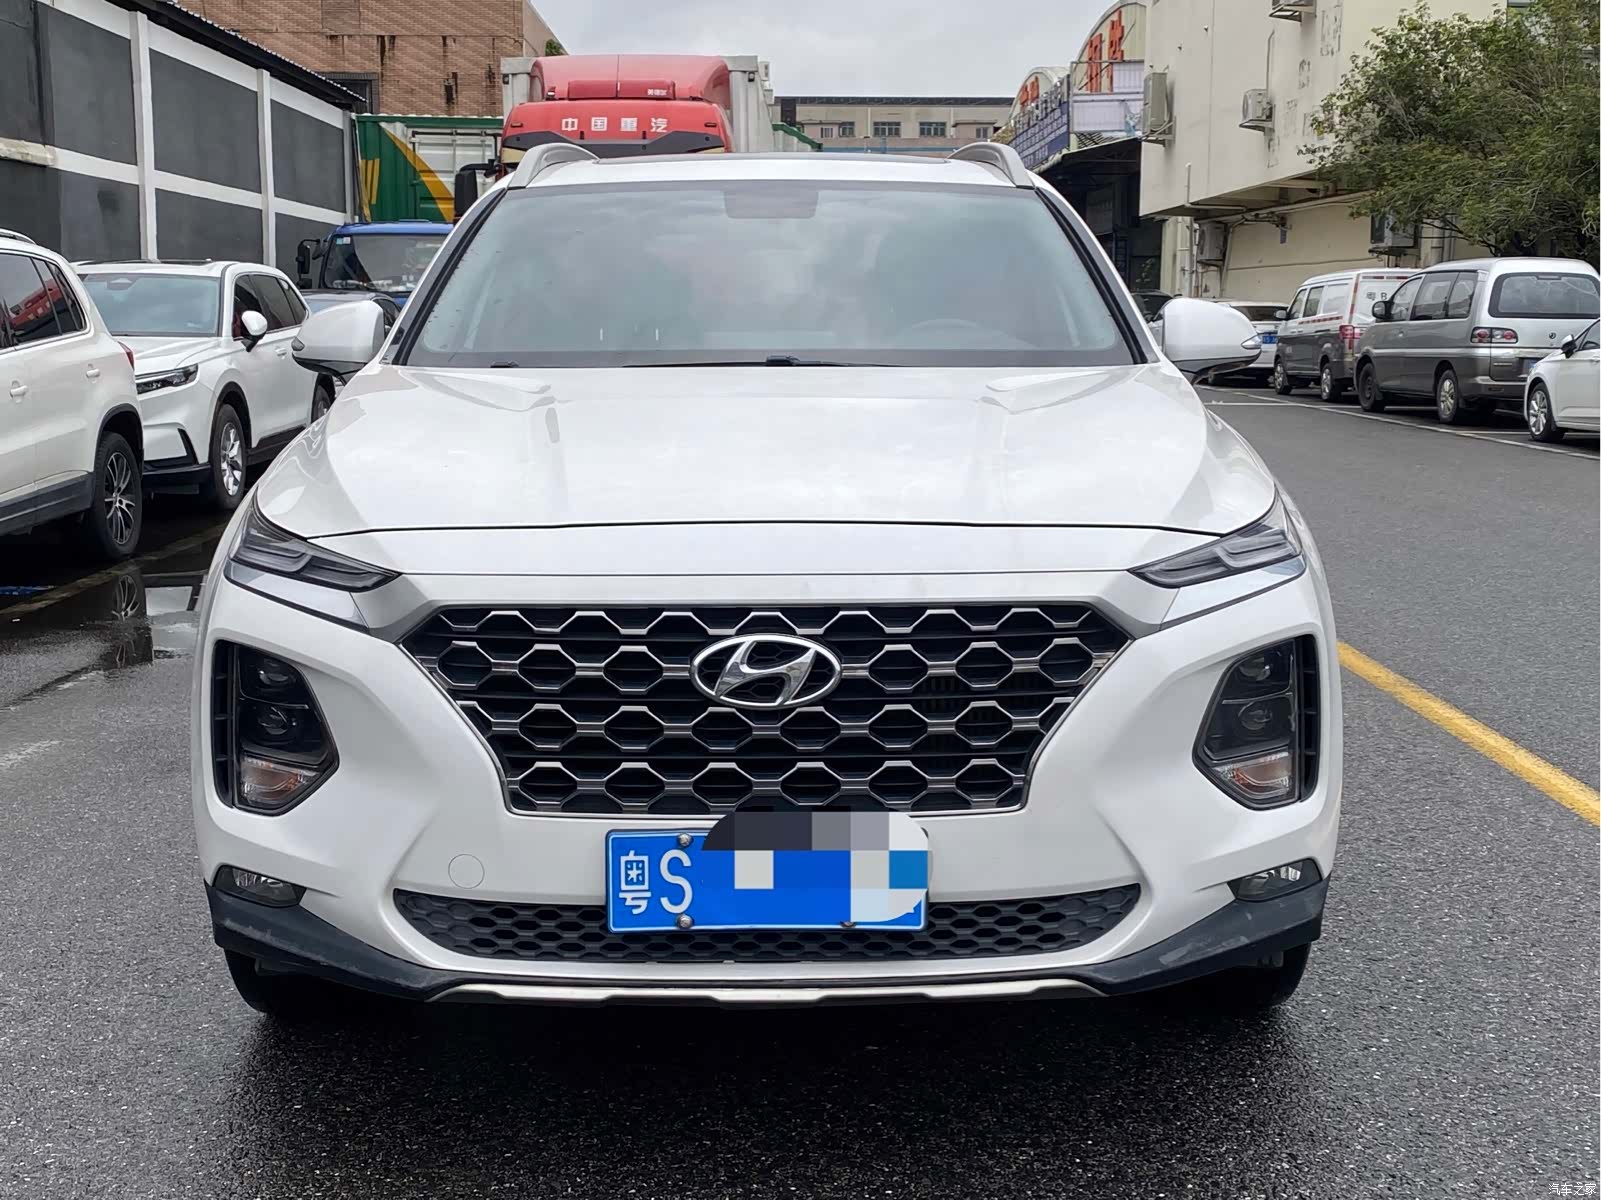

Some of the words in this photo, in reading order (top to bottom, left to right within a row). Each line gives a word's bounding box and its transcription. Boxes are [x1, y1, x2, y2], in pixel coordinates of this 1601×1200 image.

[561, 116, 668, 133] 中国重汽
[618, 849, 693, 915] 粤S
